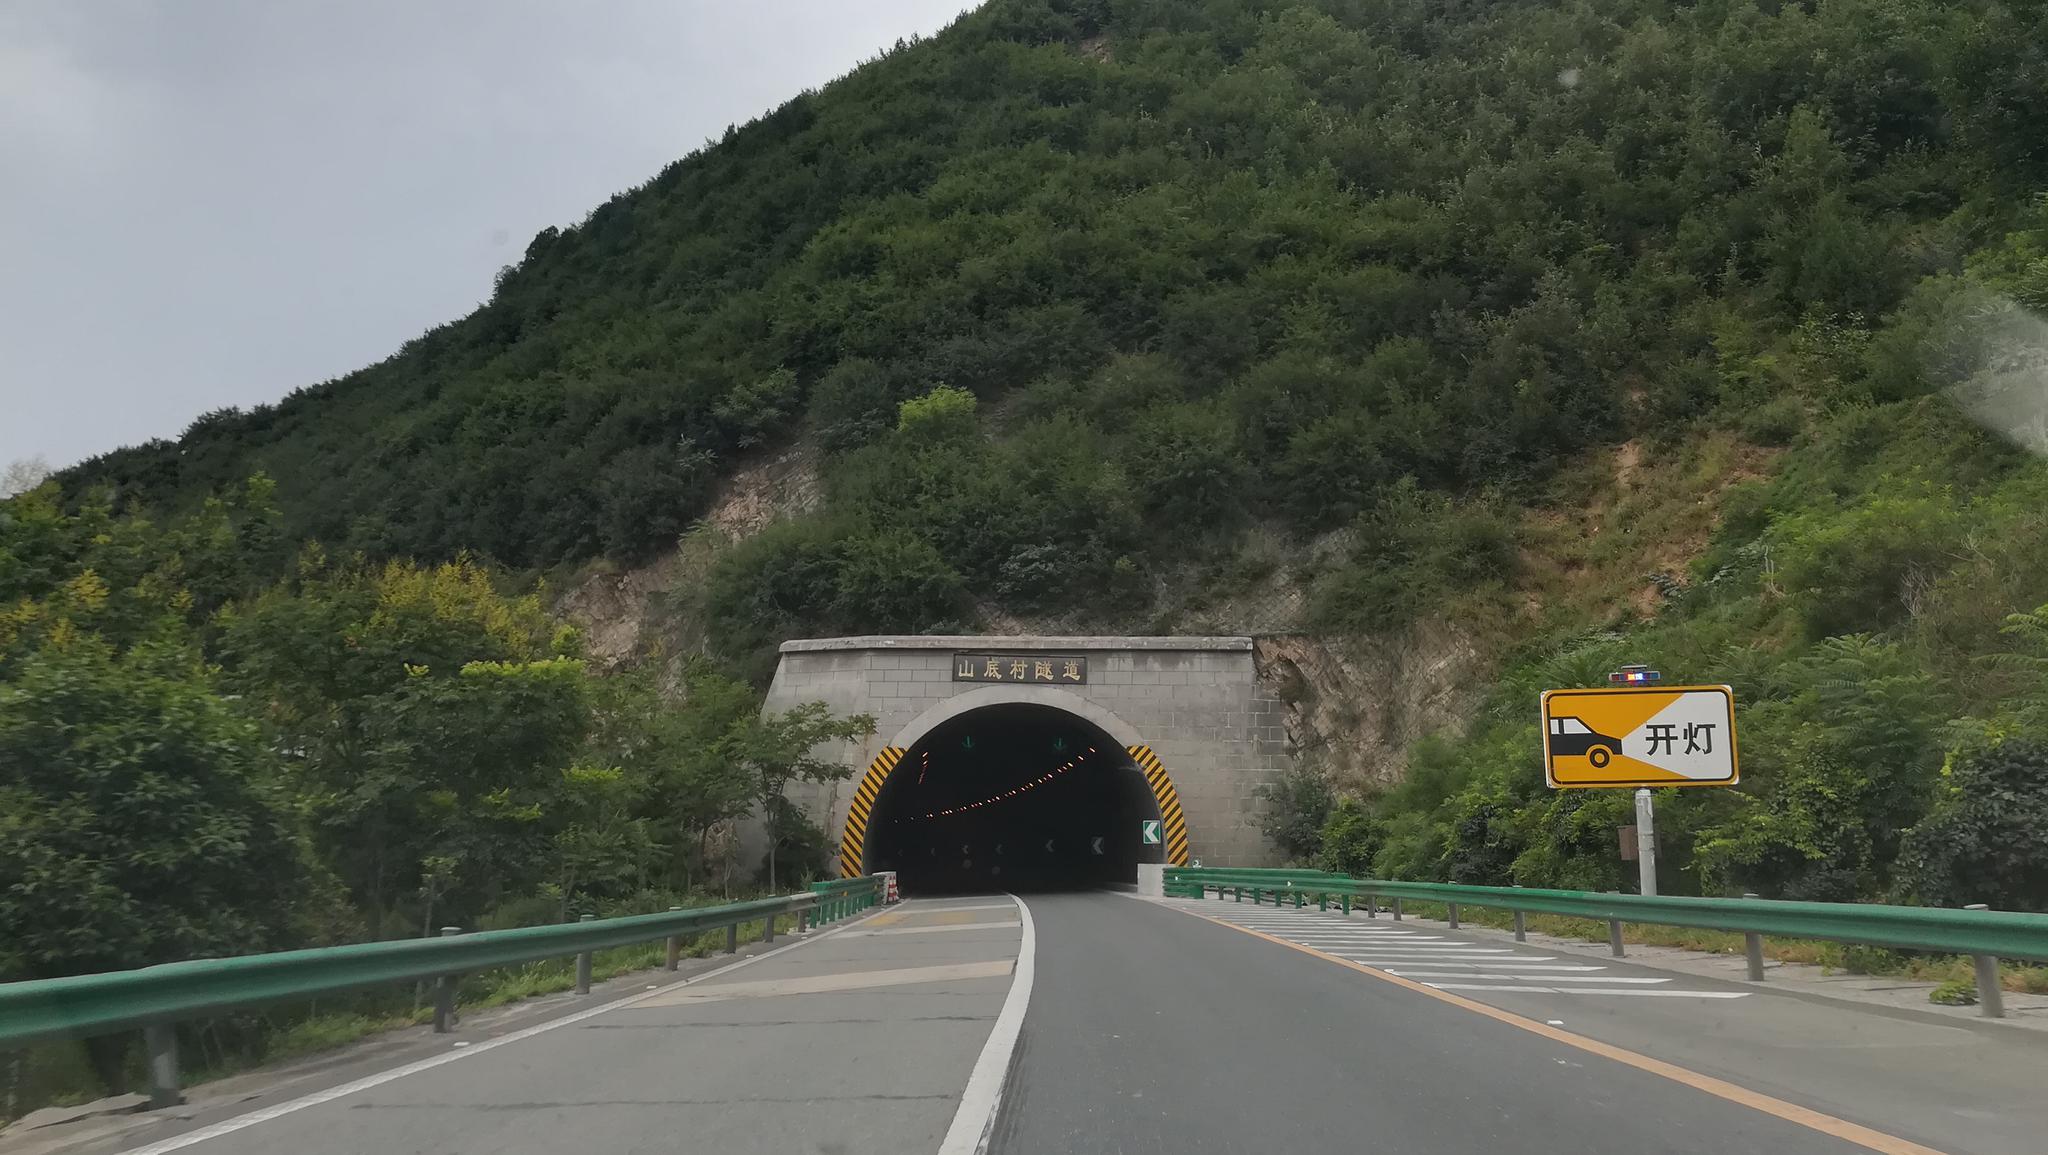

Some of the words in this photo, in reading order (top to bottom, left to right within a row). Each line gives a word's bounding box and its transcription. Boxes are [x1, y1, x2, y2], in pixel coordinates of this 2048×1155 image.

[958, 658, 1081, 681] 山底村隧道
[1645, 722, 1716, 755] 开灯
